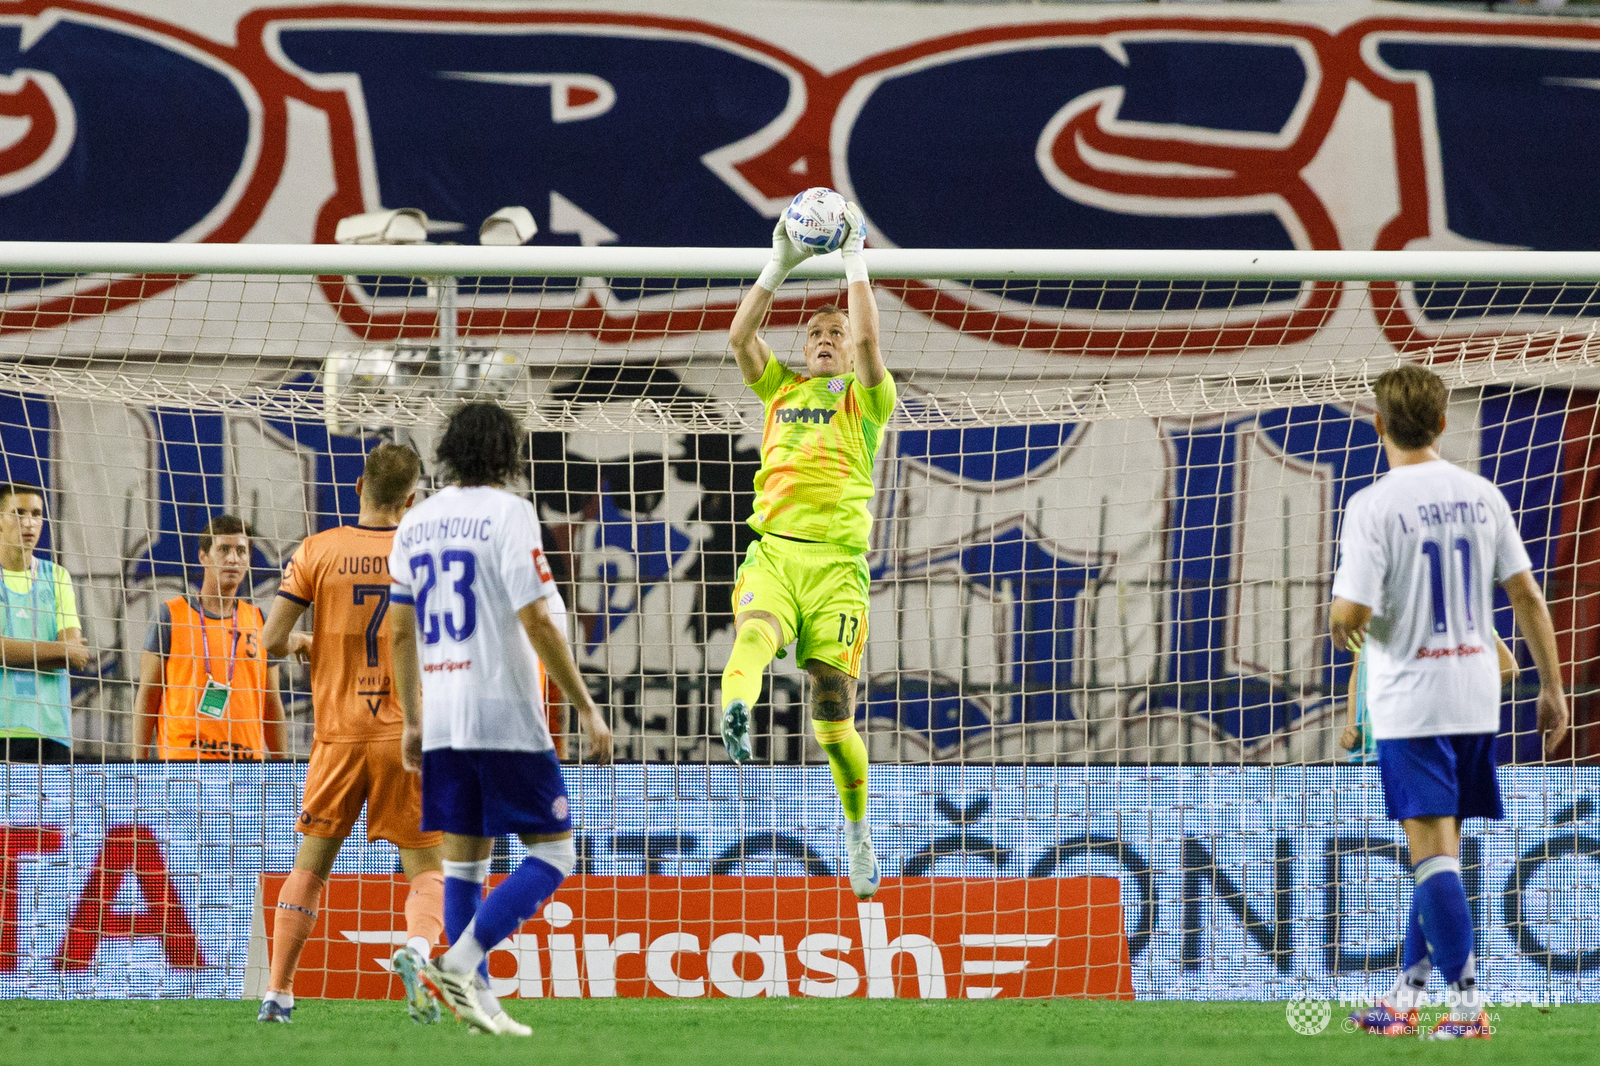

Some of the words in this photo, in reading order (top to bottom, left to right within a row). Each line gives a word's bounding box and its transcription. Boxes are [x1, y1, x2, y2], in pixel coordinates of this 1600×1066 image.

[776, 408, 837, 425] TOMMY
[353, 584, 391, 667] 7
[409, 548, 477, 645] 23
[838, 613, 859, 647] 13
[1421, 537, 1475, 634] 11
[487, 901, 947, 999] aircash
